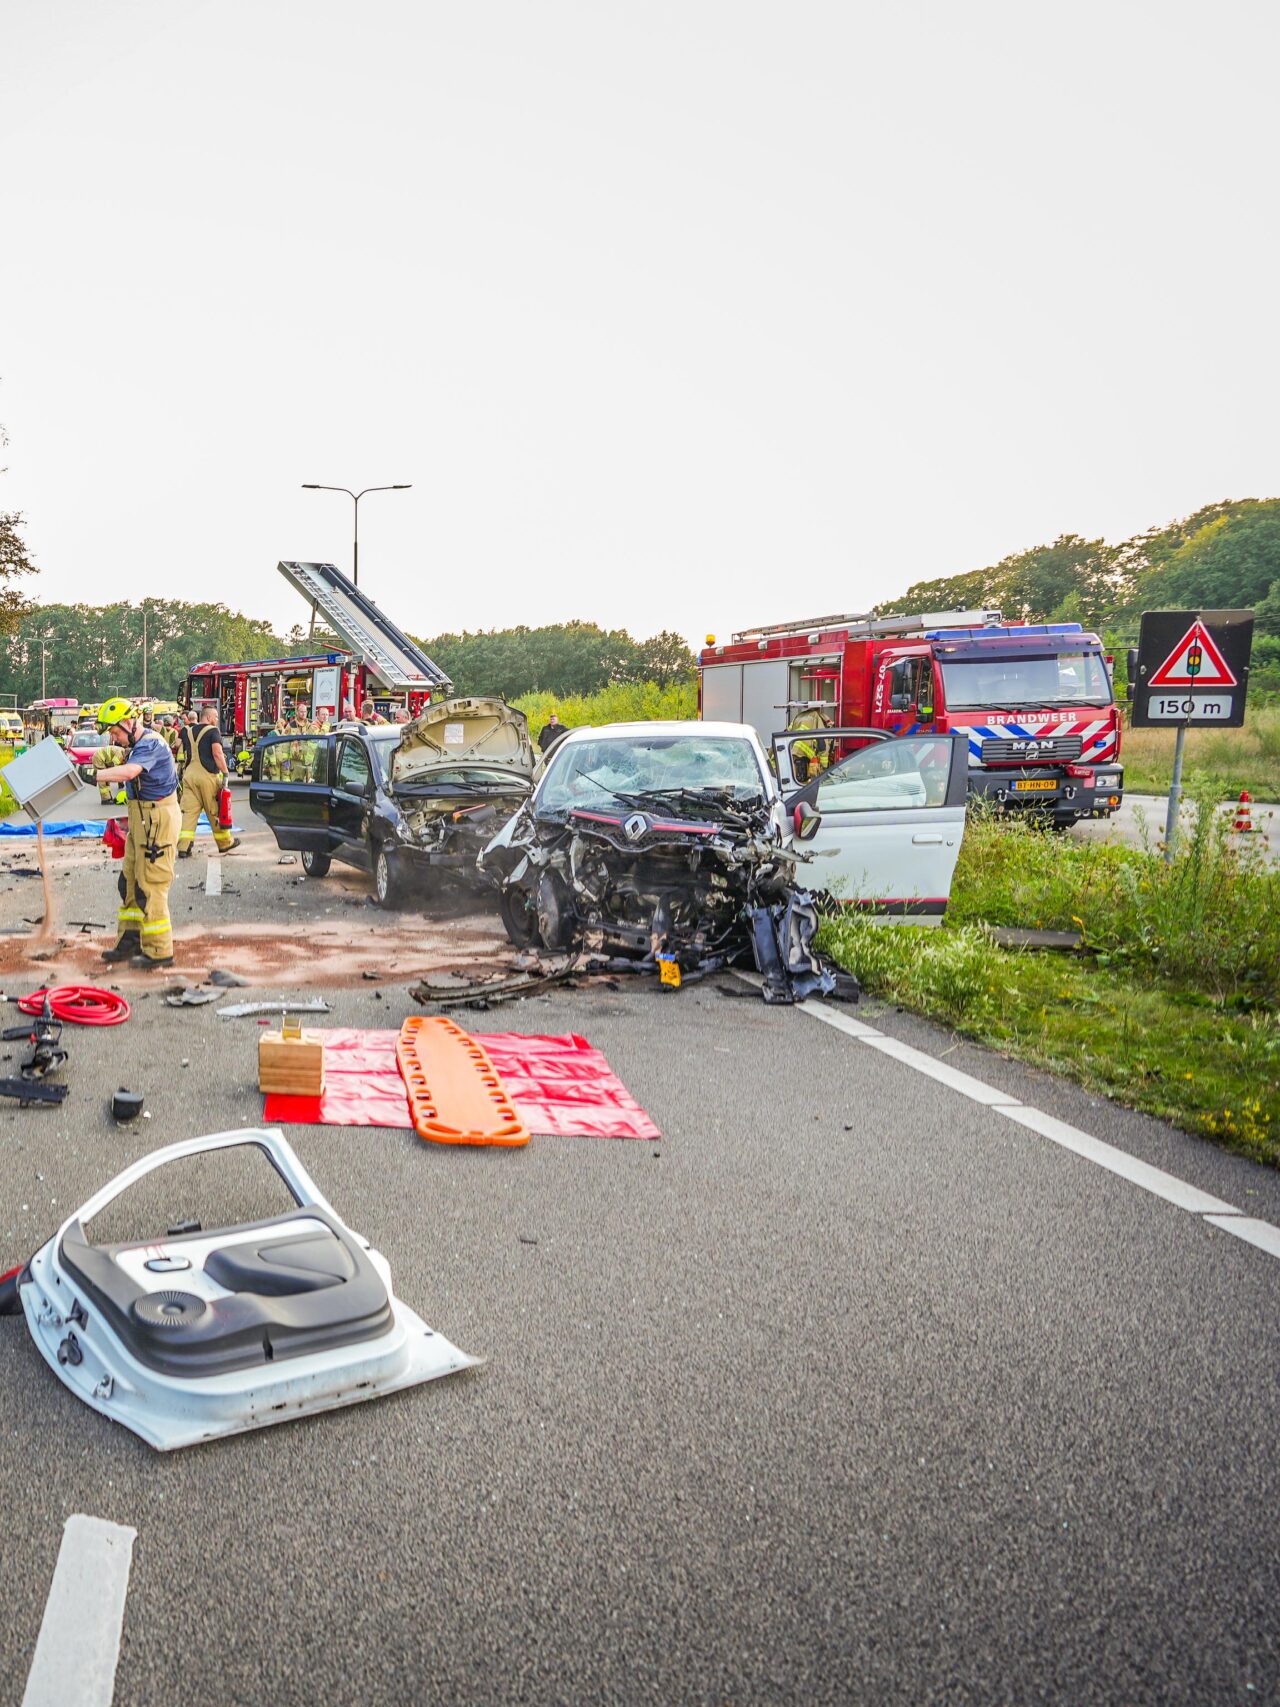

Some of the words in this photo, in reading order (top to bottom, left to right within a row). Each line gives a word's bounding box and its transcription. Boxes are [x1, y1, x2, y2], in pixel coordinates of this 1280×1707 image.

[875, 664, 886, 713] 07-5271
[1159, 700, 1195, 714] 150
[1203, 703, 1221, 714] m
[987, 712, 1077, 725] BRANDWEER
[1013, 741, 1054, 750] MAN
